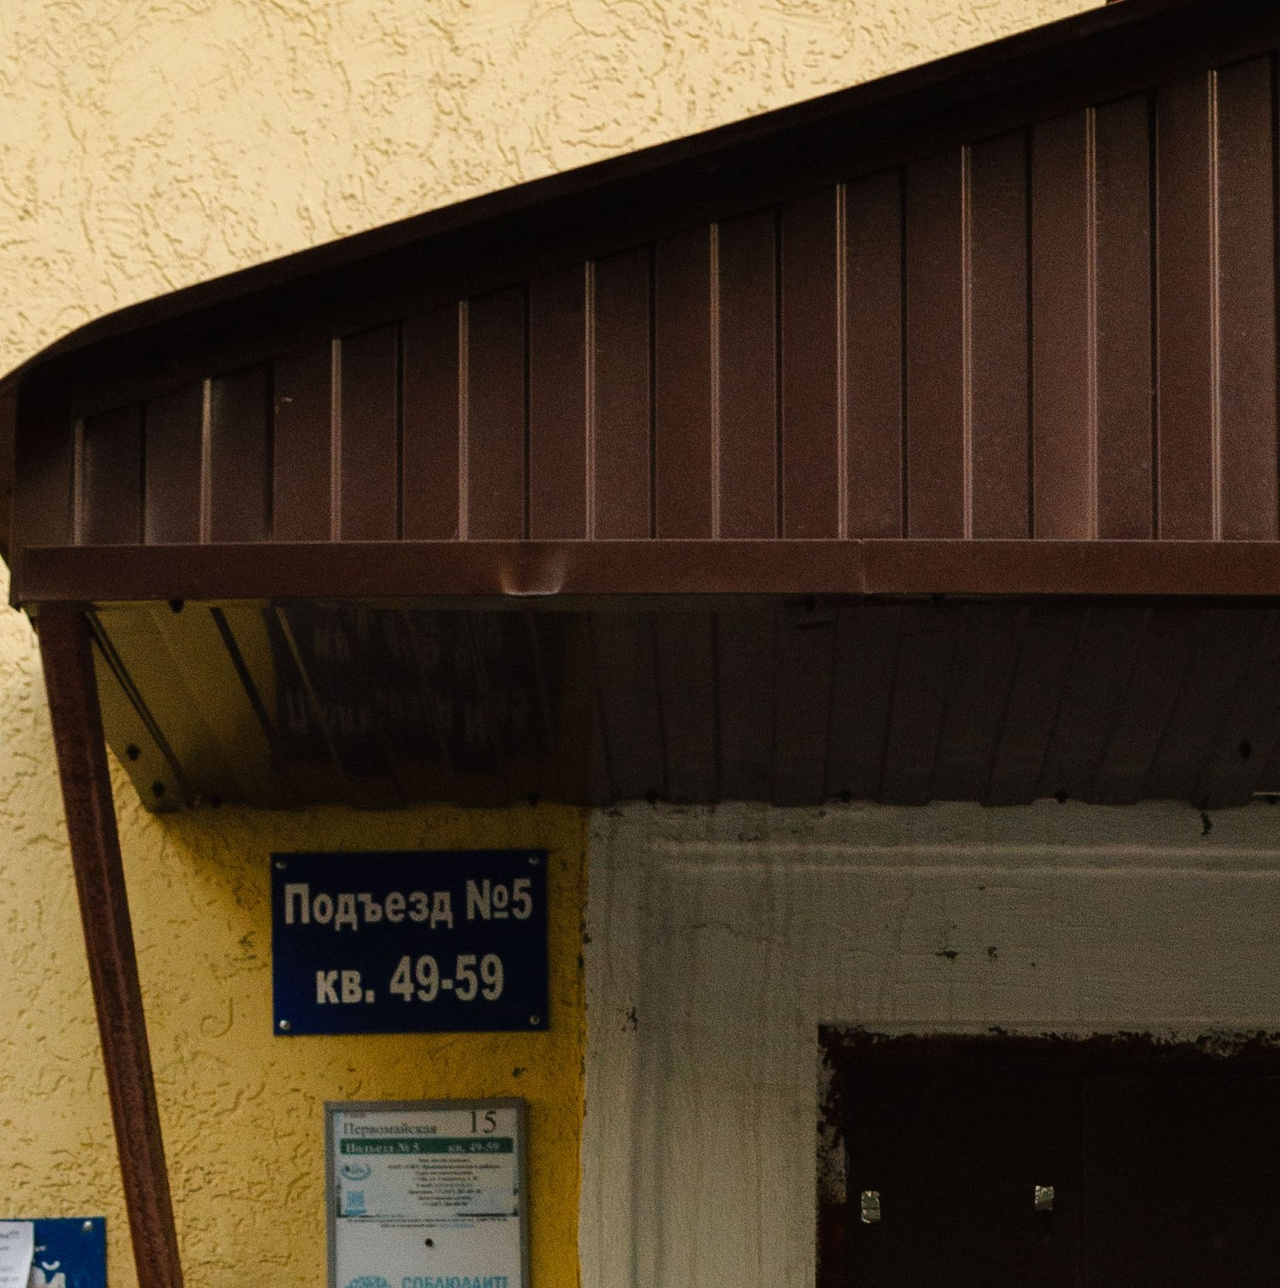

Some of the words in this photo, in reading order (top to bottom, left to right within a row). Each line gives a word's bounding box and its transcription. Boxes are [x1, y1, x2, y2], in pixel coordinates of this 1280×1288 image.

[283, 877, 455, 932] Подъезд
[465, 877, 534, 921] №5
[315, 969, 376, 1004] кв.
[388, 953, 505, 1003] 49-59
[343, 1122, 438, 1137] Первомайская
[468, 1110, 498, 1135] 15
